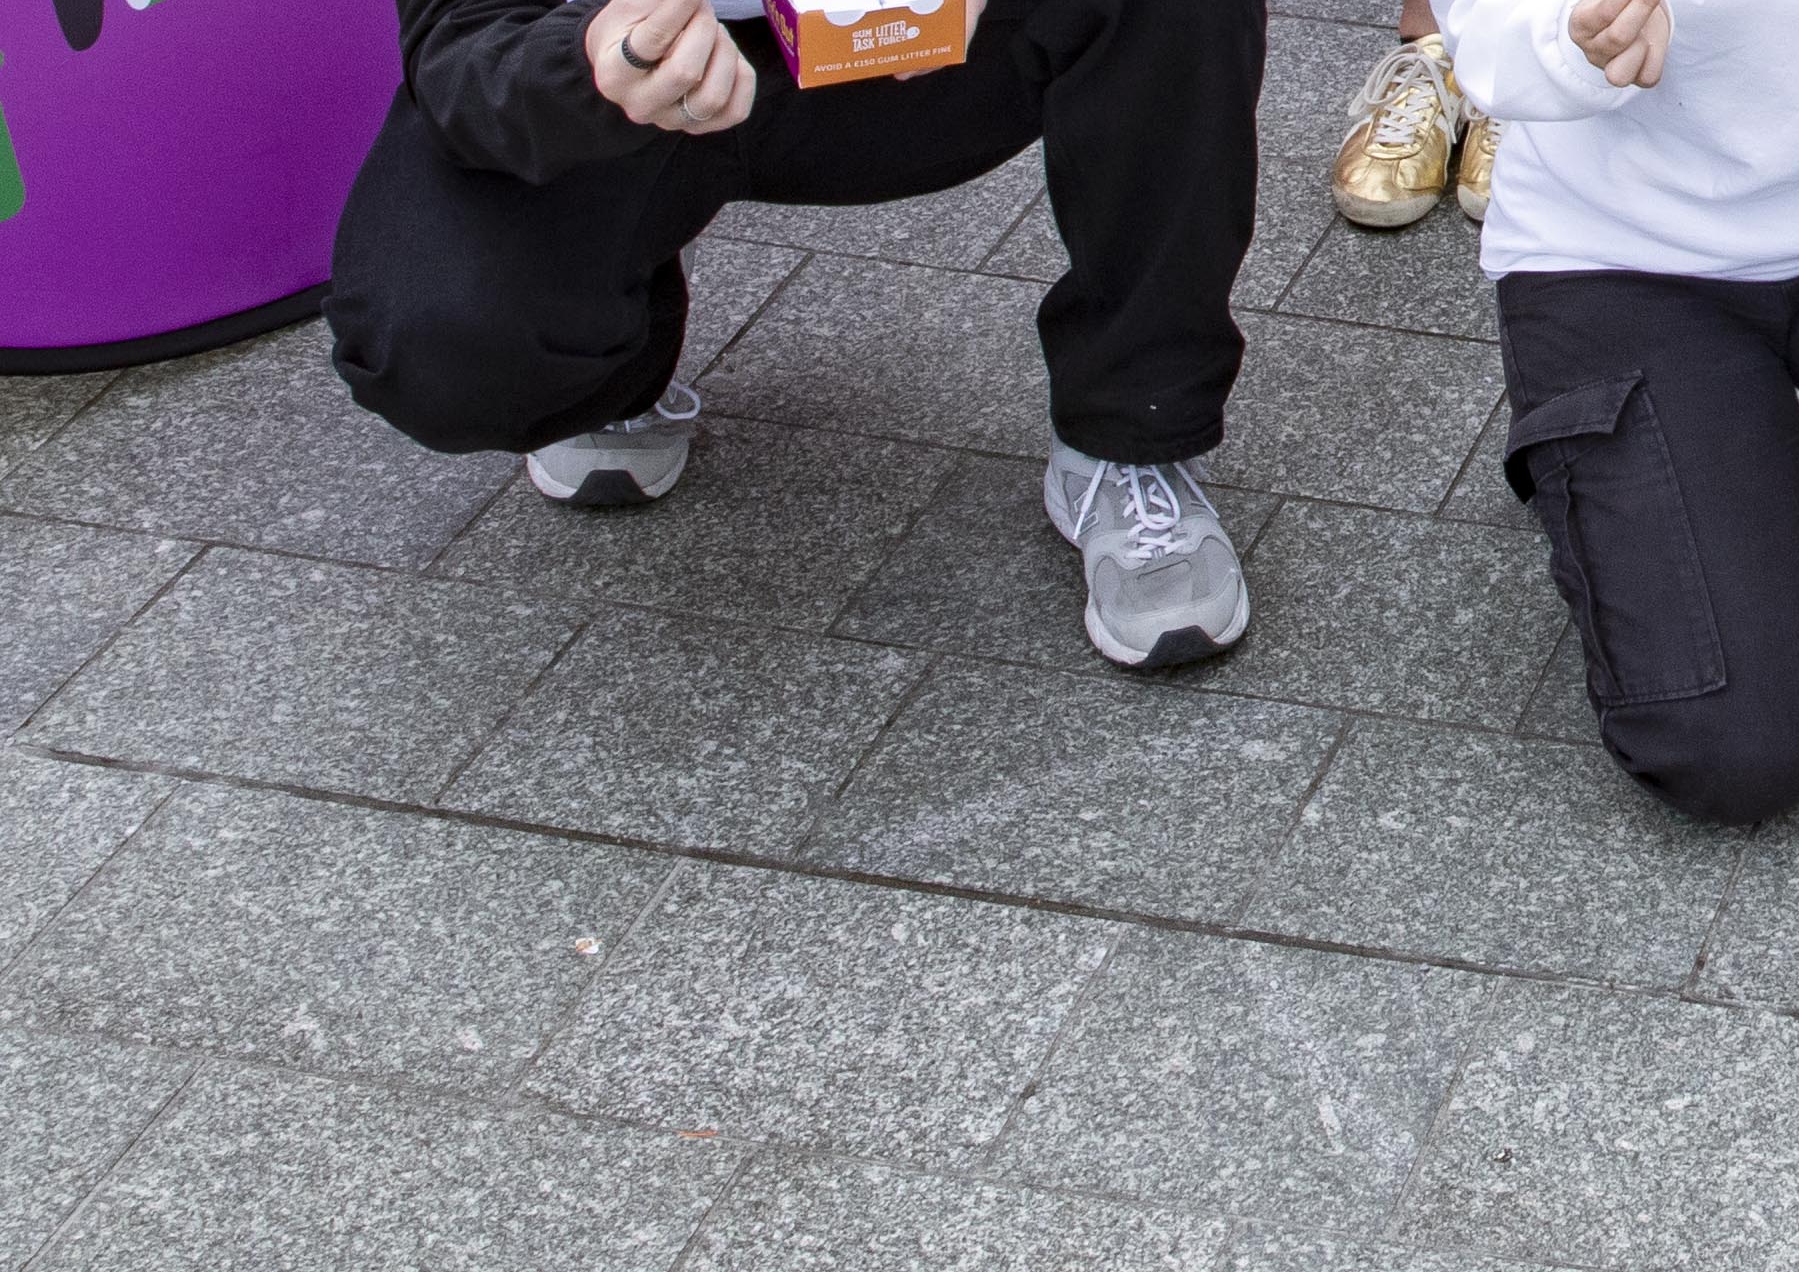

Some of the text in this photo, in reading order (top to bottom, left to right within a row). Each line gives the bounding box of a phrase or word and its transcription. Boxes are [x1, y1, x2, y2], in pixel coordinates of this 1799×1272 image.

[852, 21, 906, 39] GUM LITTER
[852, 34, 907, 52] TASK FORCE
[814, 63, 843, 73] AVOID
[844, 61, 851, 69] A
[877, 54, 900, 65] GUM
[901, 48, 931, 61] LITTER
[932, 45, 952, 56] FINE
